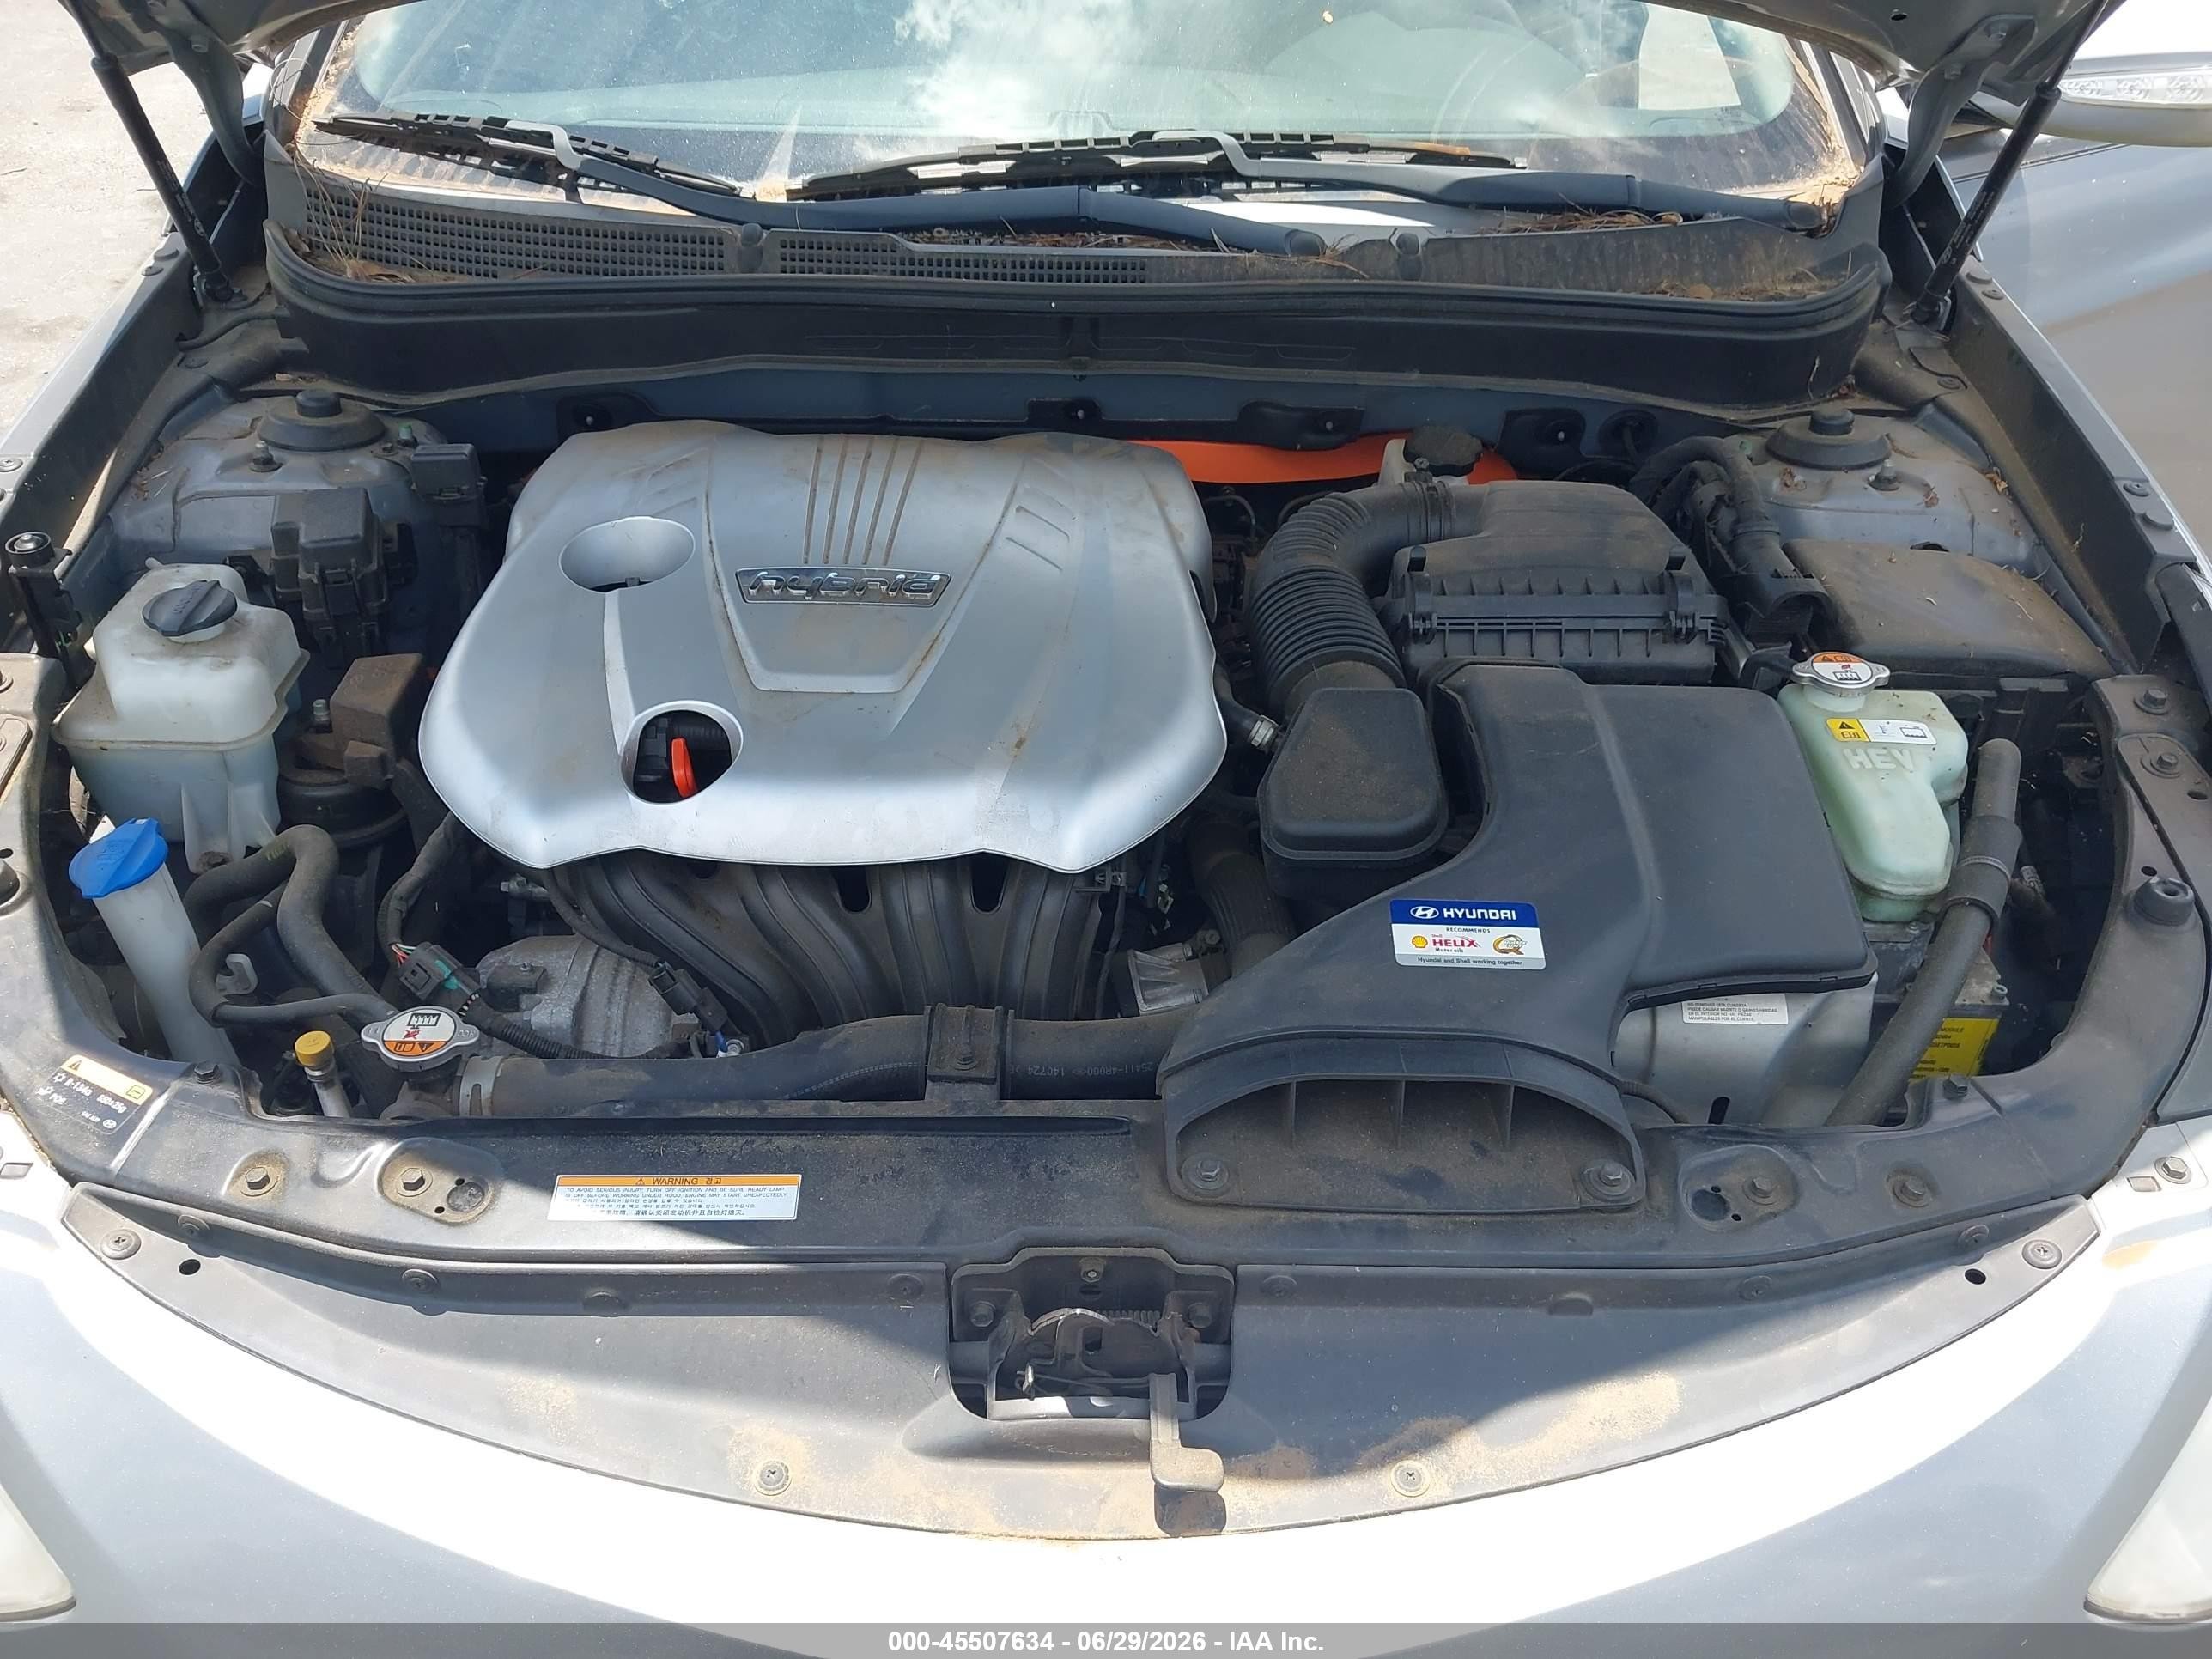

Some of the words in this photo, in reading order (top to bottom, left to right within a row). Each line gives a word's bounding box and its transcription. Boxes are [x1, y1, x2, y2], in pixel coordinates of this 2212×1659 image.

[749, 572, 941, 599] hybrid
[1843, 748, 1915, 770] HEV
[1443, 908, 1516, 921] HYUNDAI
[1431, 939, 1479, 948] HELIX
